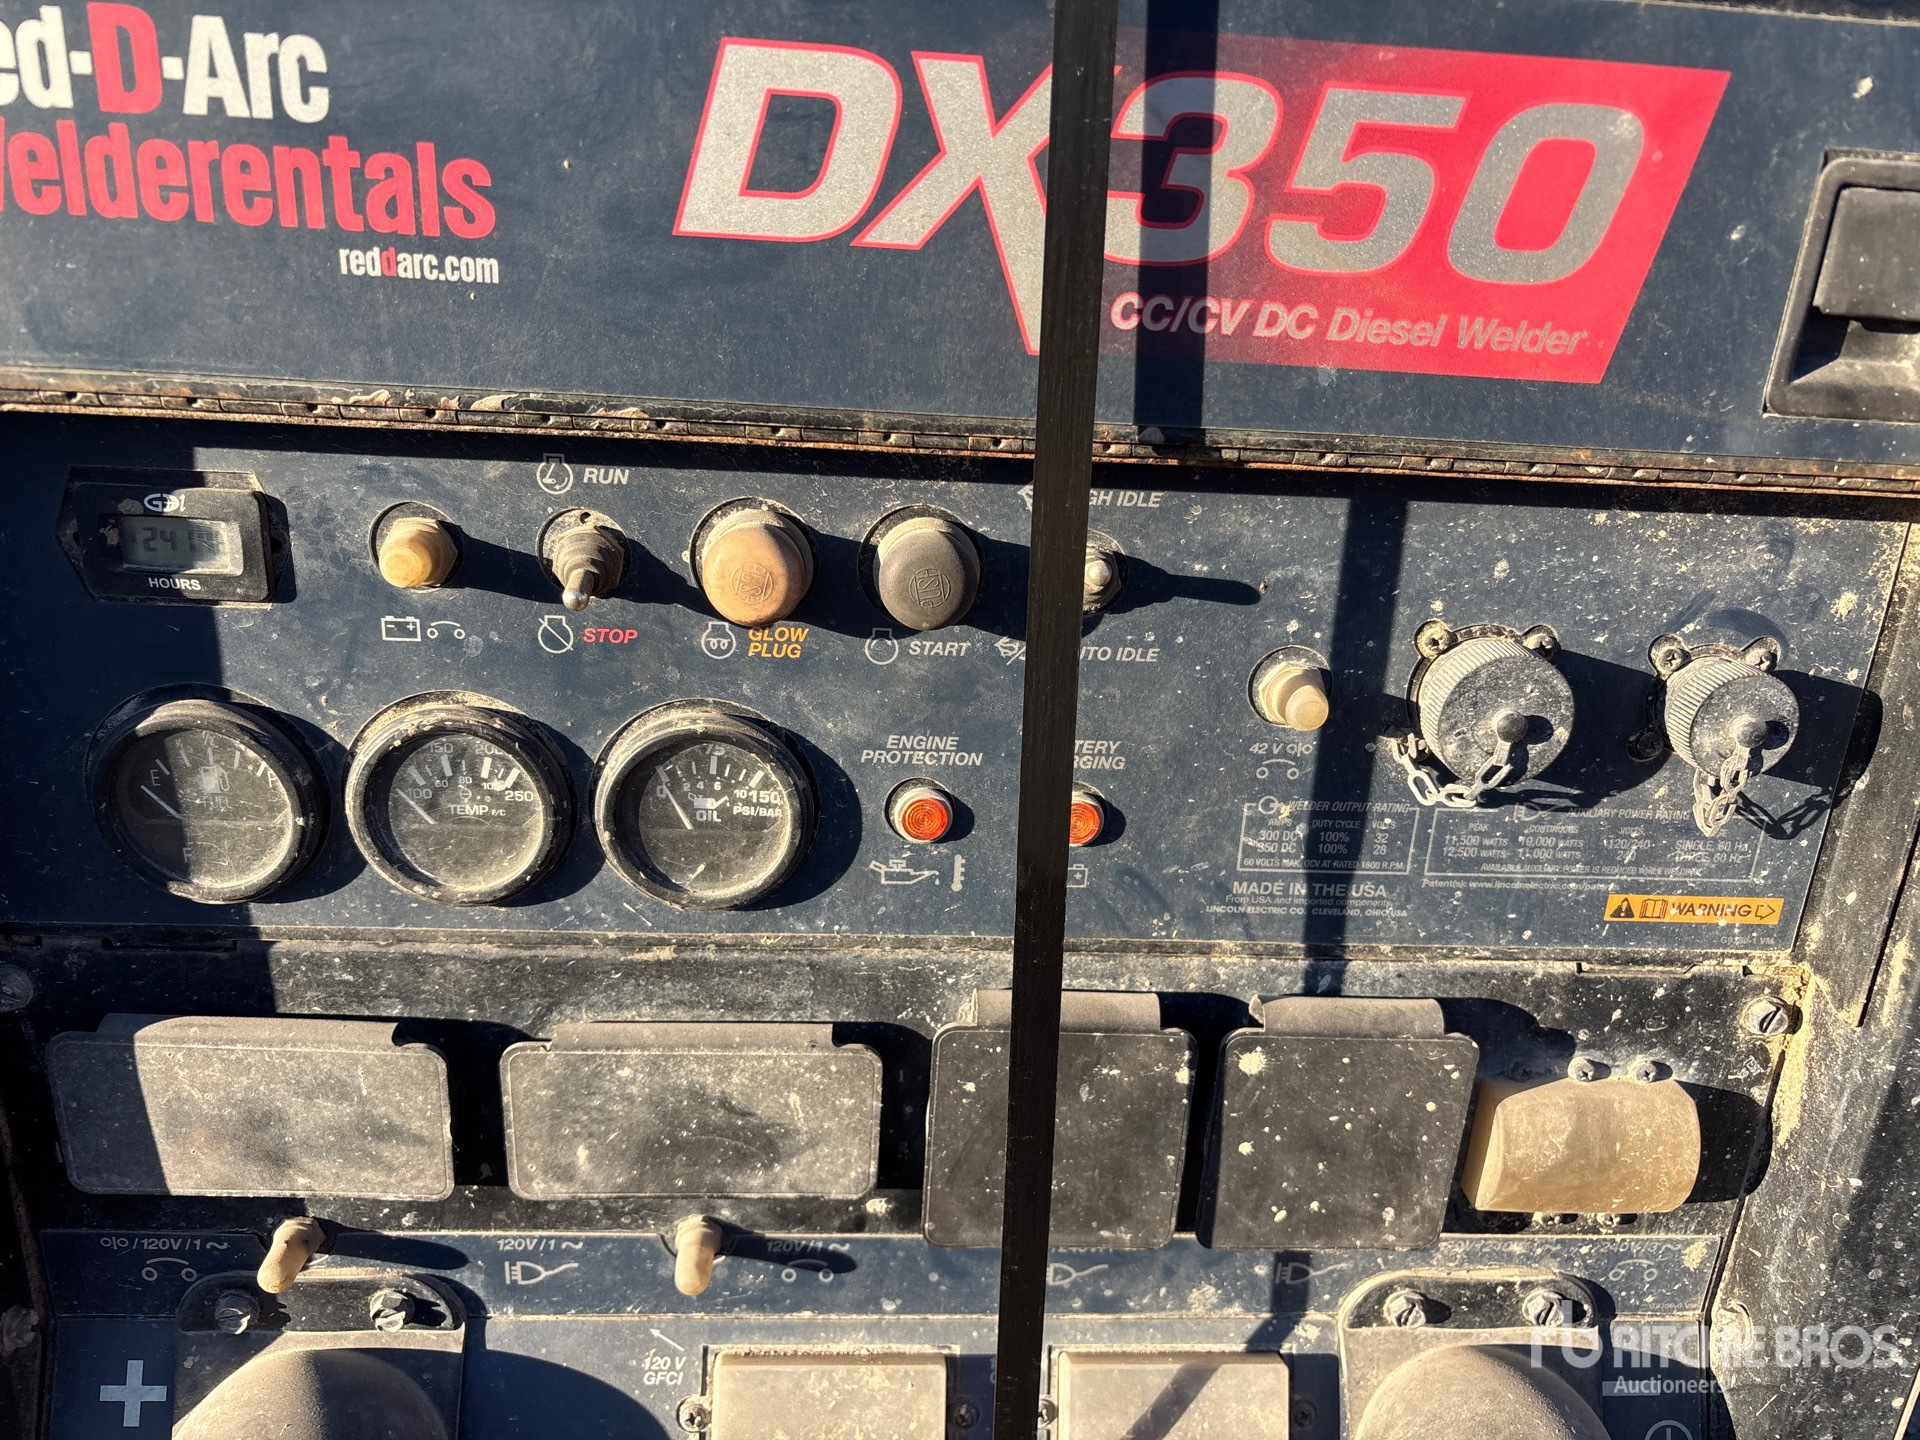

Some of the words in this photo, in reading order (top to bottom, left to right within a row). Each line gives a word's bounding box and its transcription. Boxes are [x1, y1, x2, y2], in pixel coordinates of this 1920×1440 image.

[0, 115, 497, 239] elderentals
[672, 36, 1646, 356] DX350
[339, 248, 499, 284] reddarc.com
[1110, 291, 1252, 336] CC/CV
[1253, 300, 1319, 340] DC
[1325, 306, 1448, 348] Diesel
[1457, 315, 1589, 355] Welder
[583, 467, 629, 485] RUN
[1089, 490, 1114, 507] GH
[1116, 491, 1163, 508] IDLE
[148, 577, 201, 591] HOURS
[583, 627, 638, 644] STOP
[748, 626, 809, 642] GLOW
[748, 643, 801, 659] PLUG
[909, 641, 971, 657] START
[1080, 646, 1112, 662] TO
[1115, 648, 1160, 662] IDLE
[430, 742, 454, 754] 150
[887, 734, 959, 751] ENGINE
[1074, 739, 1122, 755] TERY
[861, 750, 983, 767] PROTECTION
[1073, 755, 1126, 770] RGING
[150, 769, 161, 787] E
[435, 780, 449, 788] 60
[458, 776, 473, 785] 80
[406, 788, 433, 800] 100
[505, 790, 534, 802] 250
[683, 782, 691, 791] 2
[697, 781, 705, 790] 4
[714, 781, 722, 791] 6
[734, 789, 747, 799] 10
[749, 790, 780, 804] 150
[450, 804, 489, 816] TEMP
[491, 809, 506, 817] F/C
[733, 806, 783, 817] PSI/BAR
[1288, 801, 1331, 812] WELDER
[1332, 802, 1370, 812] OUTPUT
[1372, 803, 1411, 814] RATING
[1566, 808, 1618, 819] AUXILIARY
[1618, 809, 1653, 820] POWER
[1654, 810, 1690, 821] RATING
[696, 810, 722, 823] OIL
[1312, 819, 1334, 829] DUTY
[1335, 820, 1361, 829] CYCLE
[1372, 821, 1396, 831] VOLS
[1468, 823, 1489, 832] PEAK
[1282, 831, 1298, 842] DC
[1319, 832, 1350, 843] 100%
[1374, 833, 1390, 844] 32
[1280, 843, 1297, 854] DC
[1317, 844, 1348, 855] 100%
[1372, 844, 1388, 856] 28
[1243, 859, 1255, 867] 60
[1255, 859, 1281, 868] VOLTS
[1303, 861, 1321, 869] OCV
[1321, 861, 1332, 869] AT
[1232, 881, 1285, 895] MADE
[1288, 882, 1307, 895] IN
[1312, 883, 1347, 896] THE
[1351, 883, 1387, 898] USA
[1421, 879, 1468, 889] Patent(s):
[1225, 894, 1250, 904] From
[1251, 895, 1273, 905] USA
[1274, 896, 1292, 905] and
[1293, 896, 1334, 907] imported
[1206, 905, 1246, 914] LINCOLN
[1246, 906, 1288, 915] ELECTRIC
[1364, 909, 1390, 917] OHIO
[1672, 902, 1752, 918] WARNING
[643, 1356, 671, 1370] 120
[675, 1356, 687, 1370] V
[643, 1371, 684, 1385] GFCI
